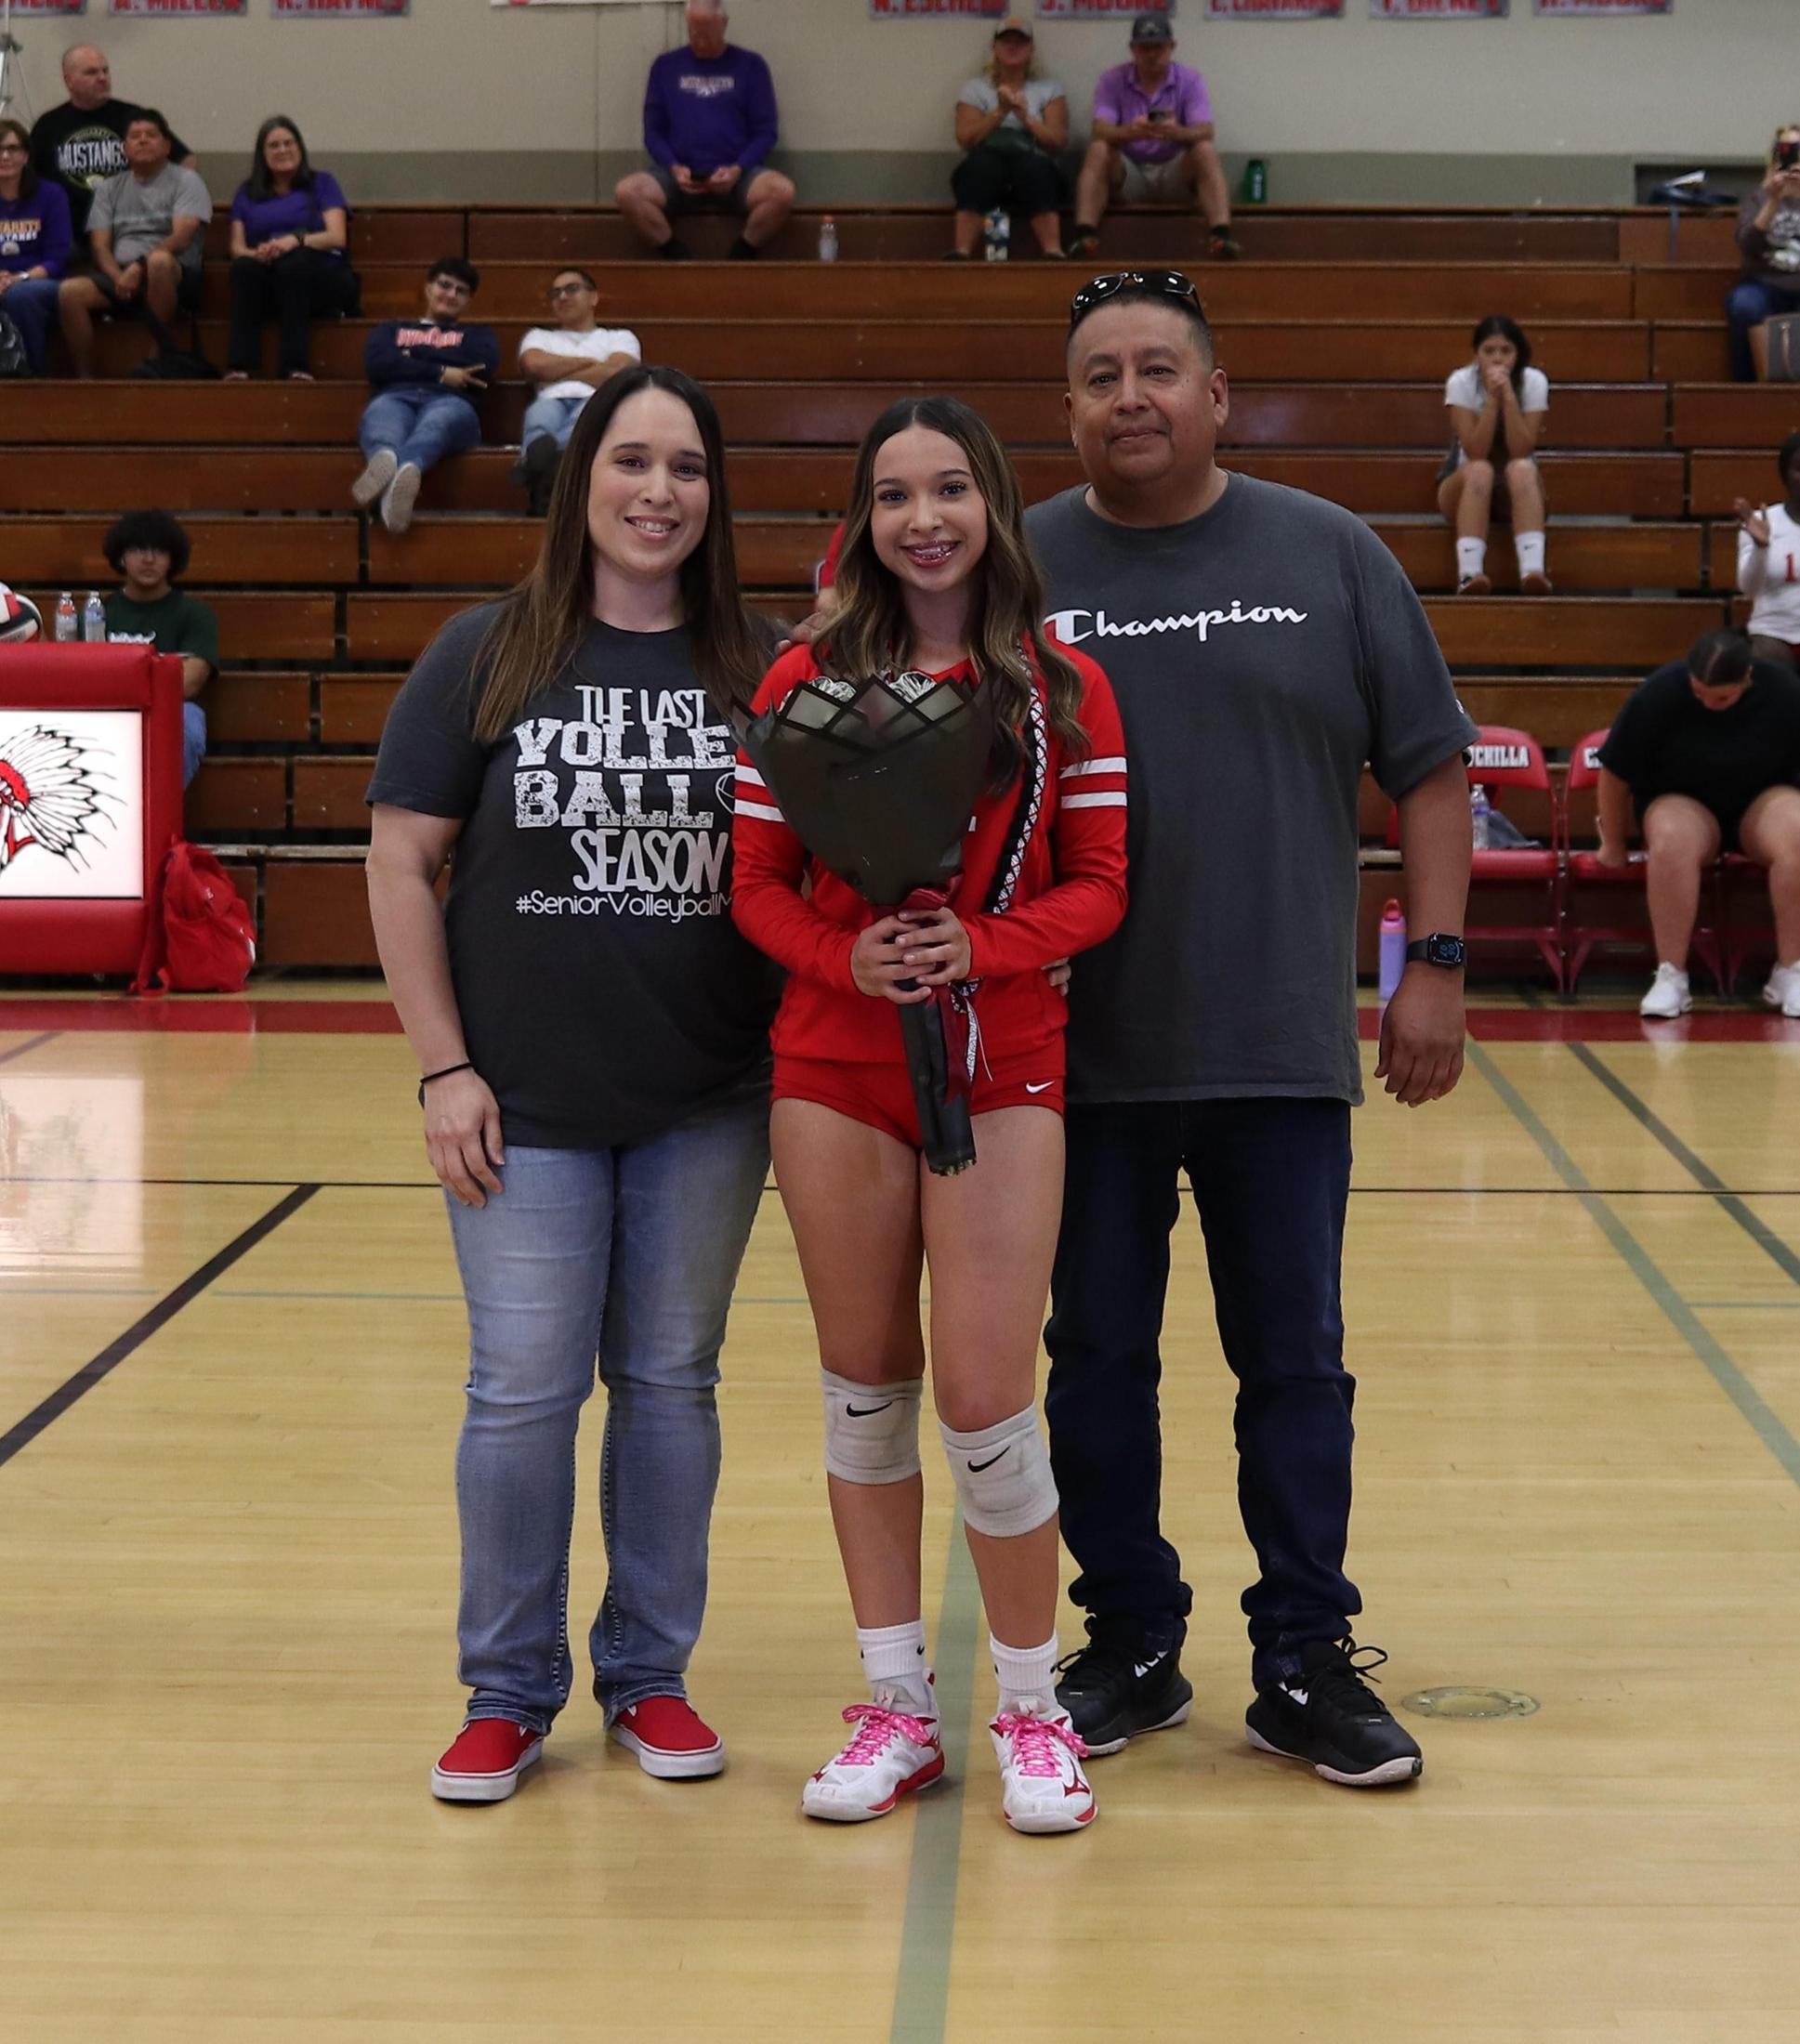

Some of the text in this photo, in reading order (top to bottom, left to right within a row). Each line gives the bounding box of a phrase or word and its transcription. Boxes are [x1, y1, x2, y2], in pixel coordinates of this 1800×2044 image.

[1043, 599, 1308, 645] Champion
[574, 685, 707, 729] THE LAST
[513, 769, 715, 829] BALL
[570, 828, 729, 894] SEASON
